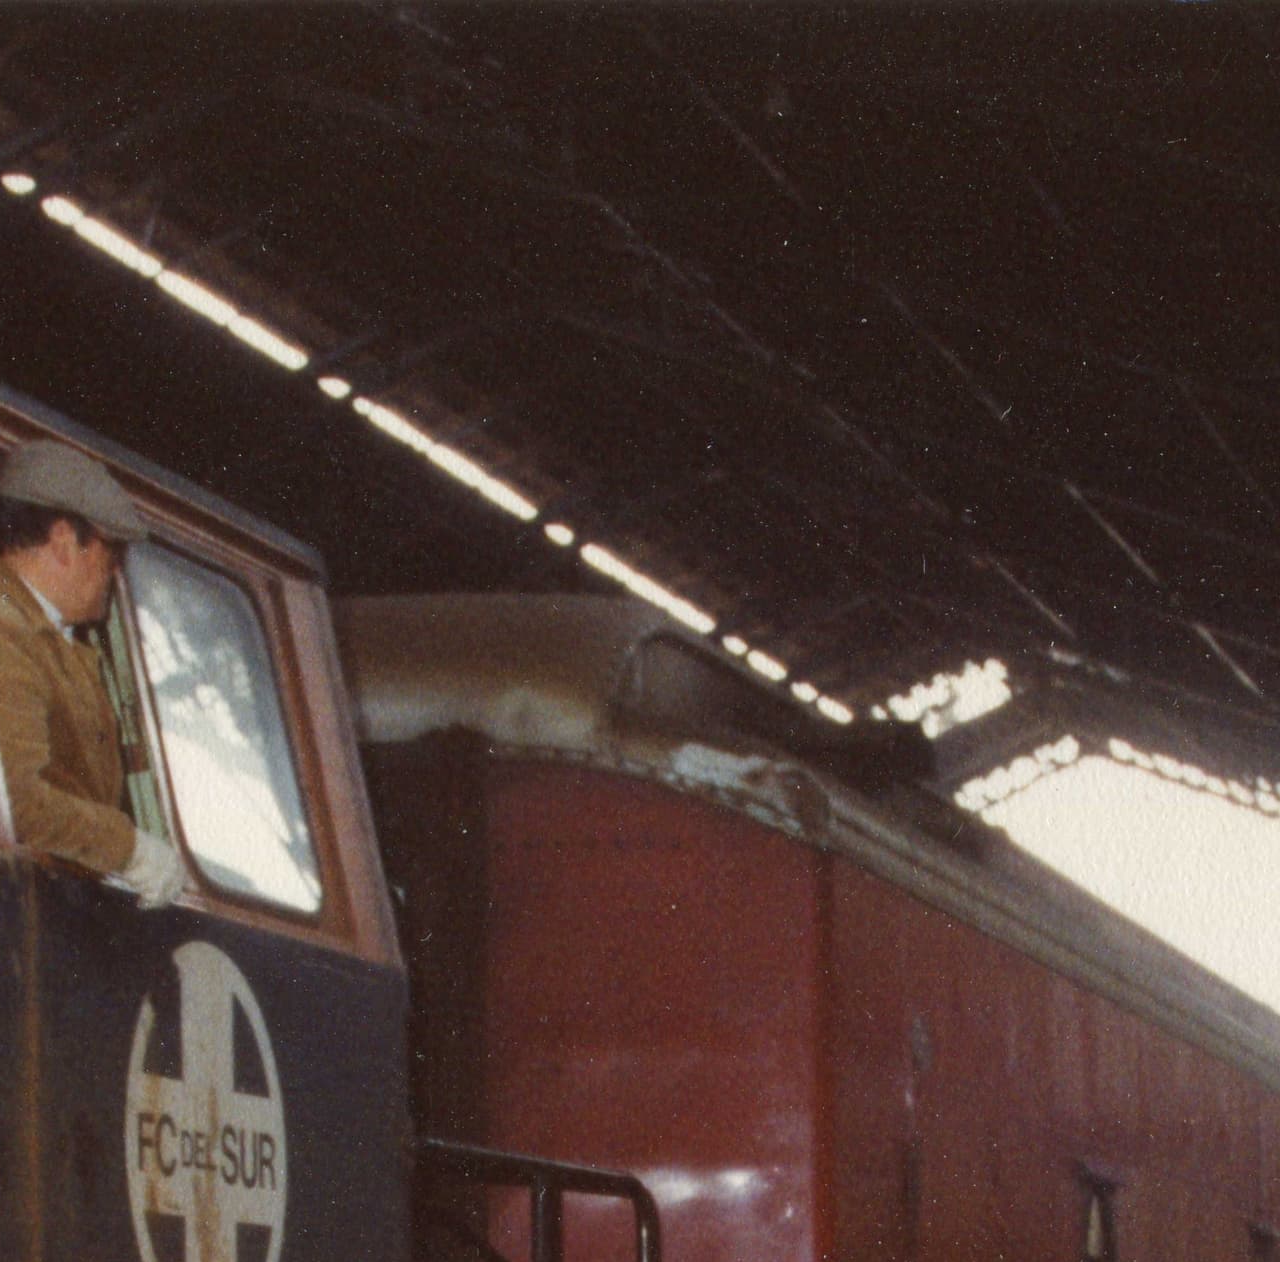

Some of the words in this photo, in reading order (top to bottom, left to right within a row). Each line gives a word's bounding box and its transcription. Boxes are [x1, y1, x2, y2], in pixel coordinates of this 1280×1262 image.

[138, 1112, 177, 1177] FC
[181, 1130, 217, 1170] DEL
[221, 1124, 276, 1190] SUR
